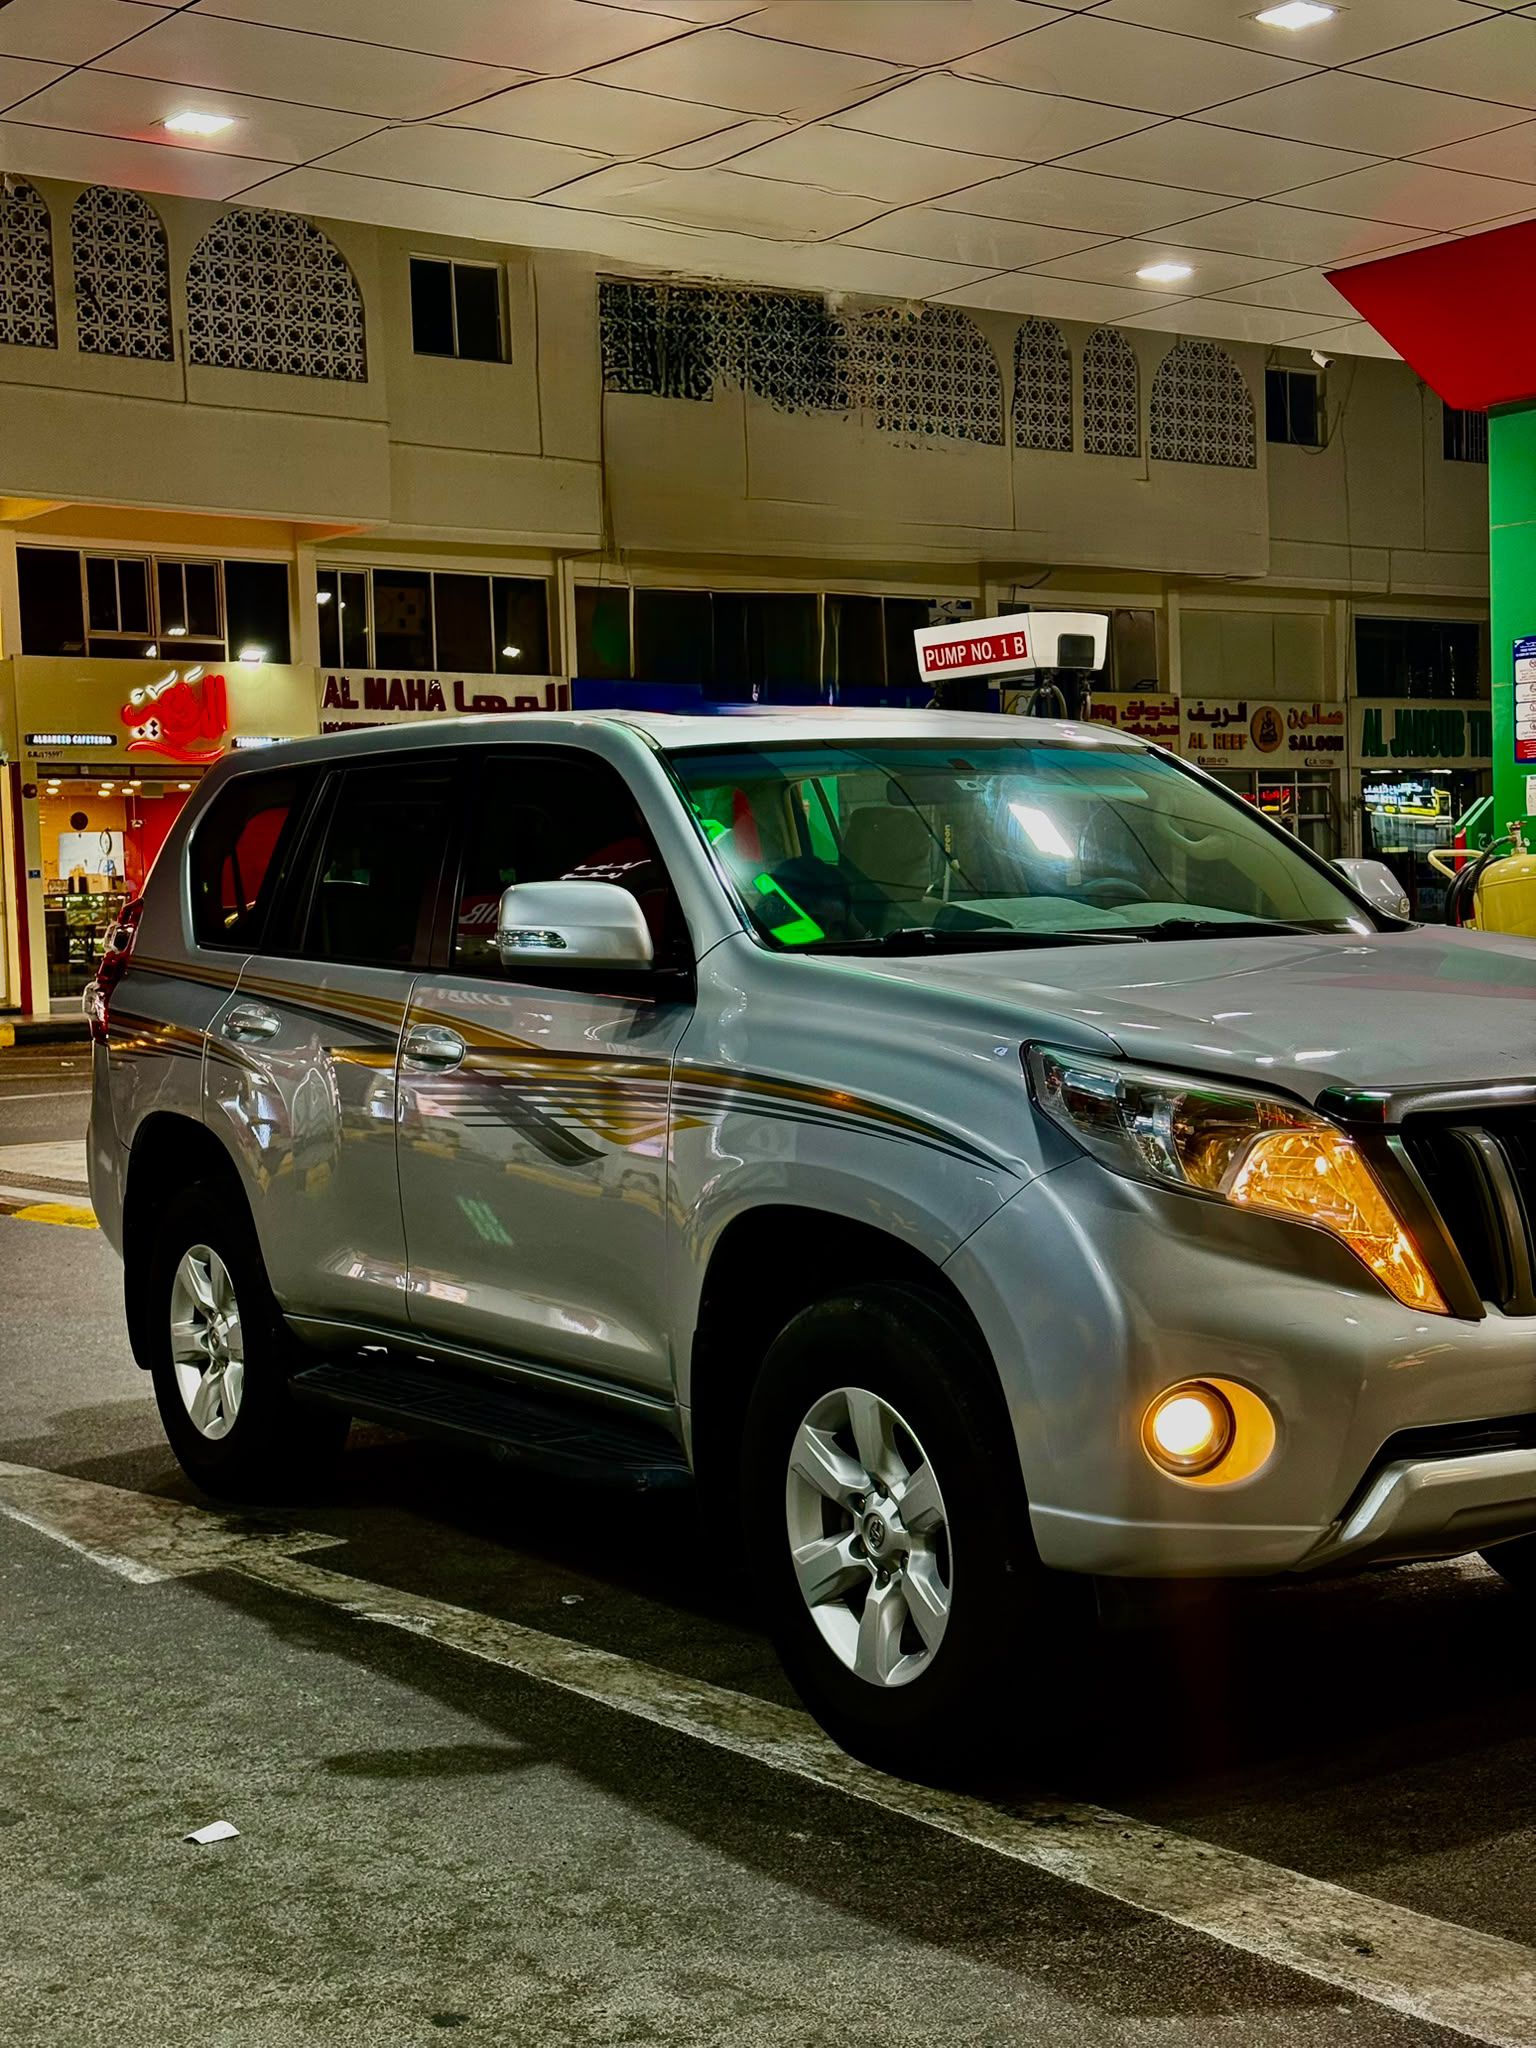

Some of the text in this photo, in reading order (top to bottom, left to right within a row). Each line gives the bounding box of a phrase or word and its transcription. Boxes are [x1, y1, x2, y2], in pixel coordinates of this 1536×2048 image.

[925, 636, 1025, 668] PUMP NO. 1 B
[322, 675, 447, 711] AL MAHA
[453, 680, 568, 713] المها
[1186, 701, 1345, 730] صالون الريف
[1187, 732, 1208, 750] AL
[1288, 735, 1345, 752] SALOON
[1361, 708, 1388, 757] AL
